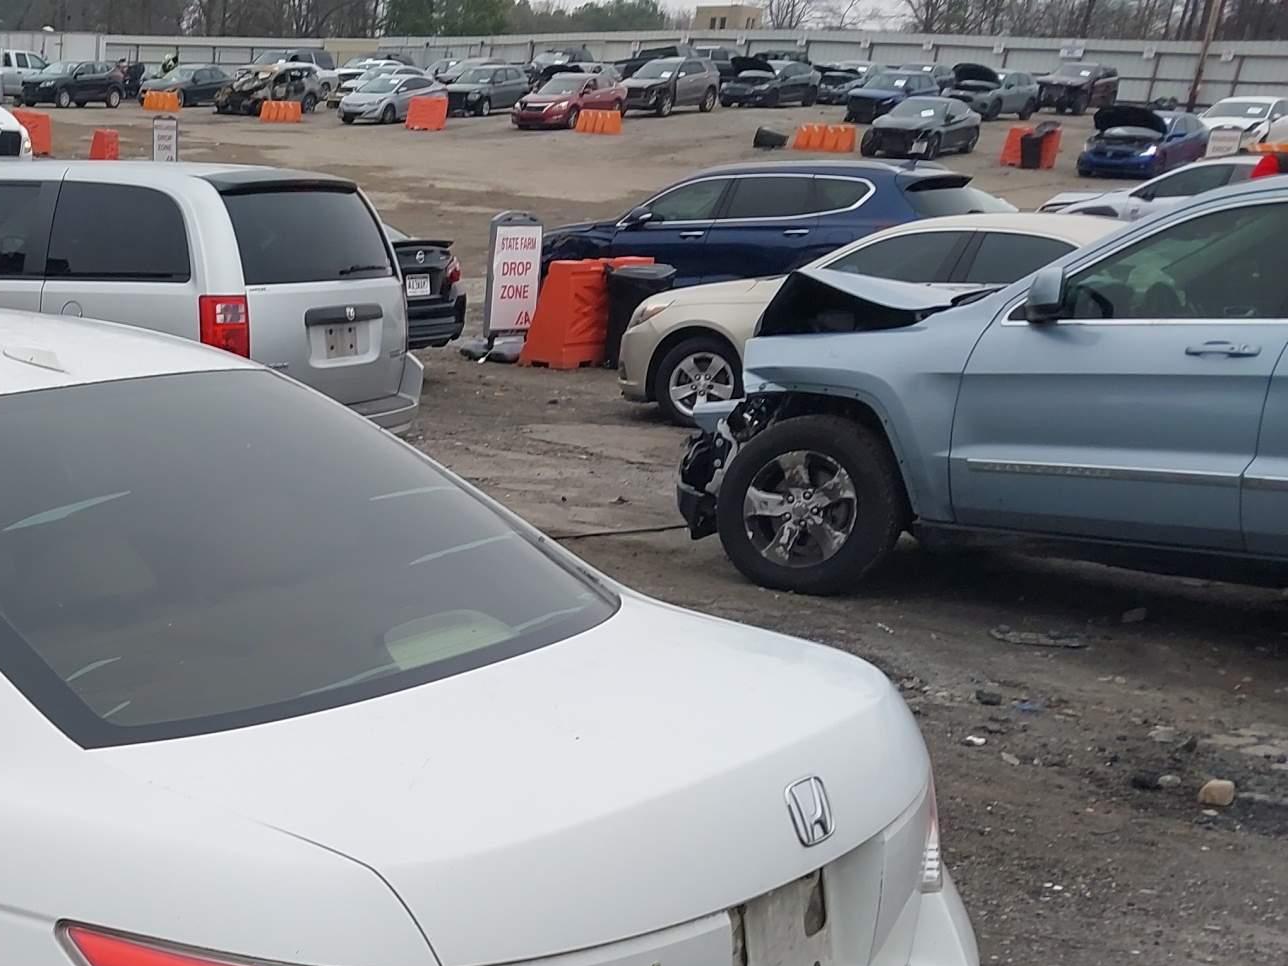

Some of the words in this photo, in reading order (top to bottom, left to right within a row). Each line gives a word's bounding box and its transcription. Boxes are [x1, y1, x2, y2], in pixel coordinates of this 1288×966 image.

[501, 237, 519, 250] STATE
[519, 236, 537, 250] FARM
[501, 261, 532, 276] DROP
[500, 284, 530, 299] ZONE
